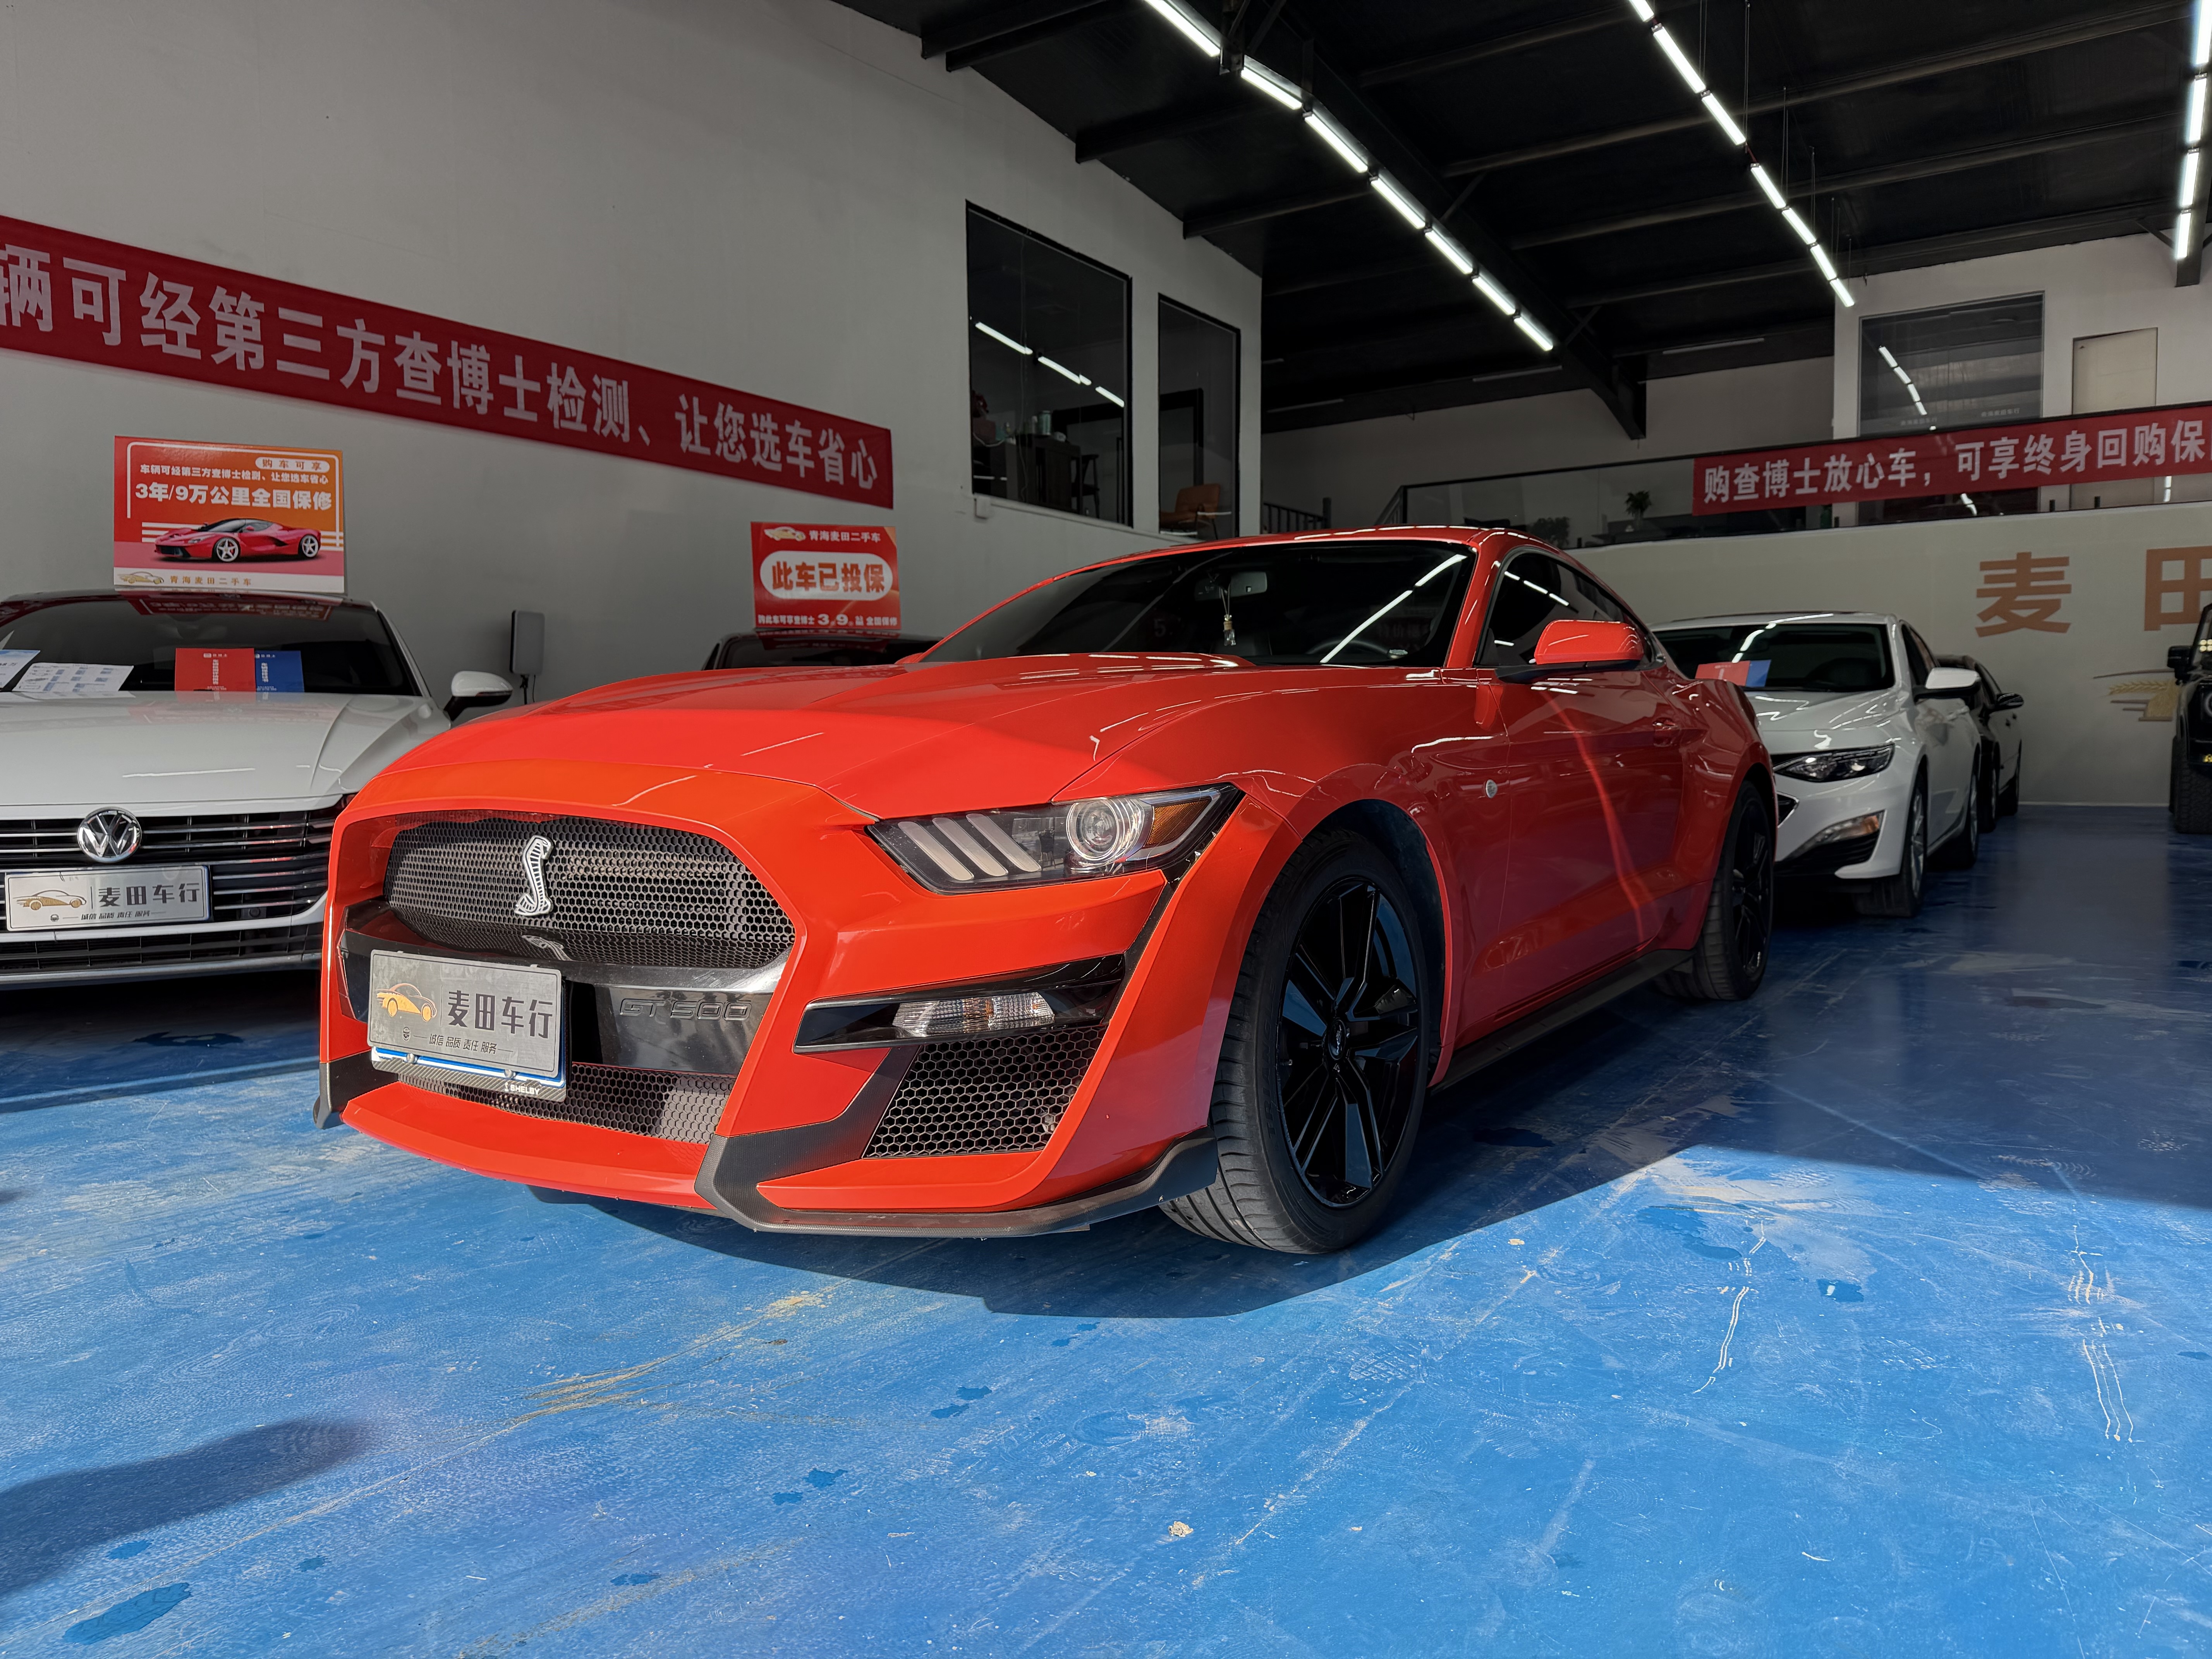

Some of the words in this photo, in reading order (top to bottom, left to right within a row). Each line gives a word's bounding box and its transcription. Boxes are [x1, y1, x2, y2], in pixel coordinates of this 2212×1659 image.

[0, 243, 878, 489] 辆可经第三方查博士检测、让您选车省心
[1704, 419, 2212, 505] 购查博士放心车，可享终身回购保
[136, 482, 332, 510] 3年/9万公里全国保修
[772, 560, 885, 593] 此车已投保
[98, 883, 200, 907] 麦田车行
[448, 989, 553, 1039] 麦田车行
[429, 1033, 444, 1046] 诚信
[446, 1036, 462, 1049] 品质
[463, 1039, 479, 1051] 责任
[481, 1041, 498, 1054] 服务
[510, 1084, 541, 1095] SHELBY
